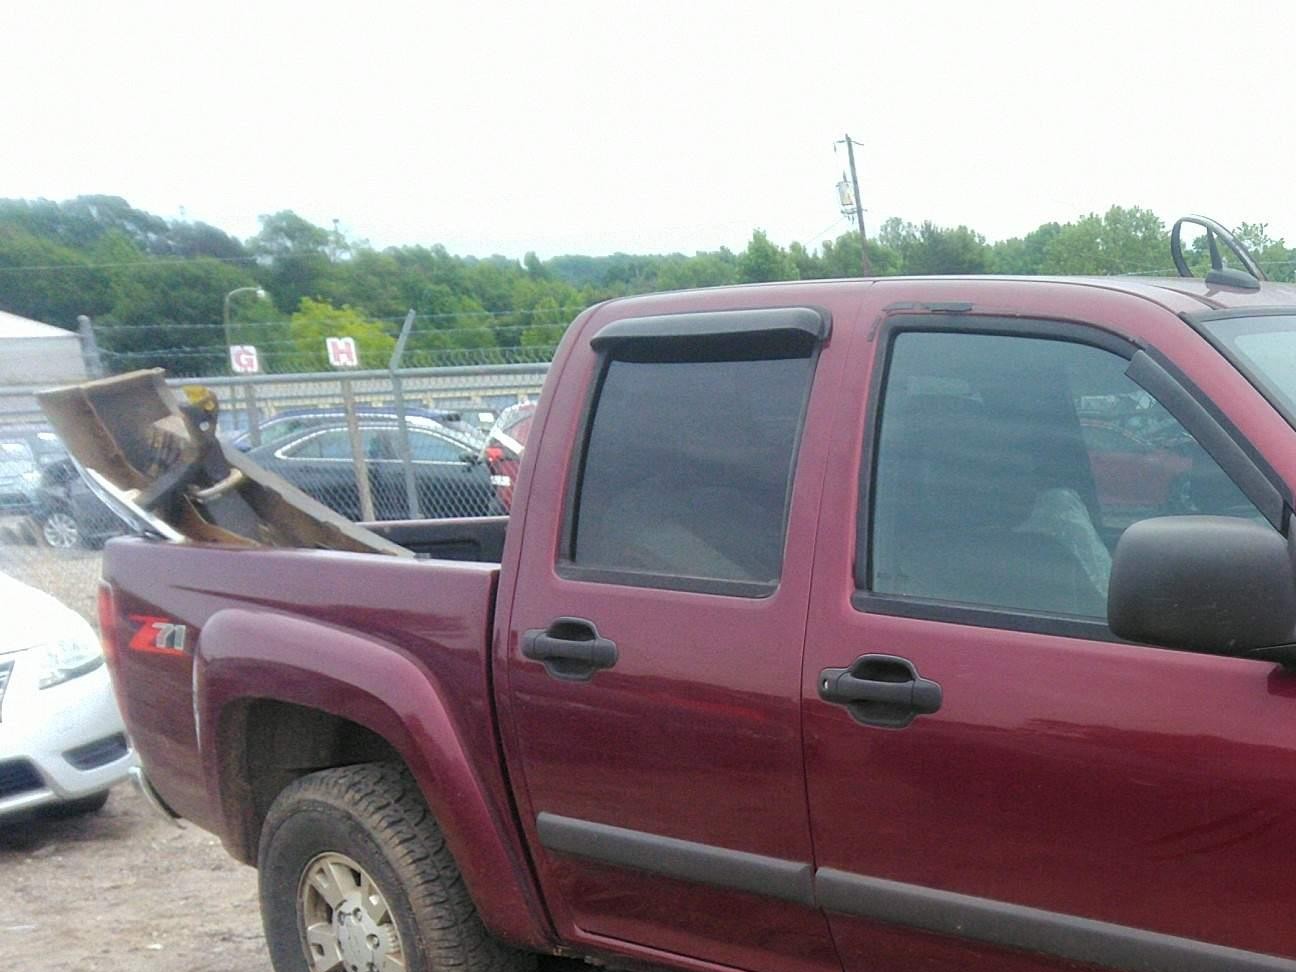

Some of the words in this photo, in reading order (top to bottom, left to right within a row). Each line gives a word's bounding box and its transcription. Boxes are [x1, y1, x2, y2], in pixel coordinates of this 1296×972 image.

[234, 349, 255, 369] G
[331, 341, 354, 363] H
[128, 612, 188, 656] Z71
